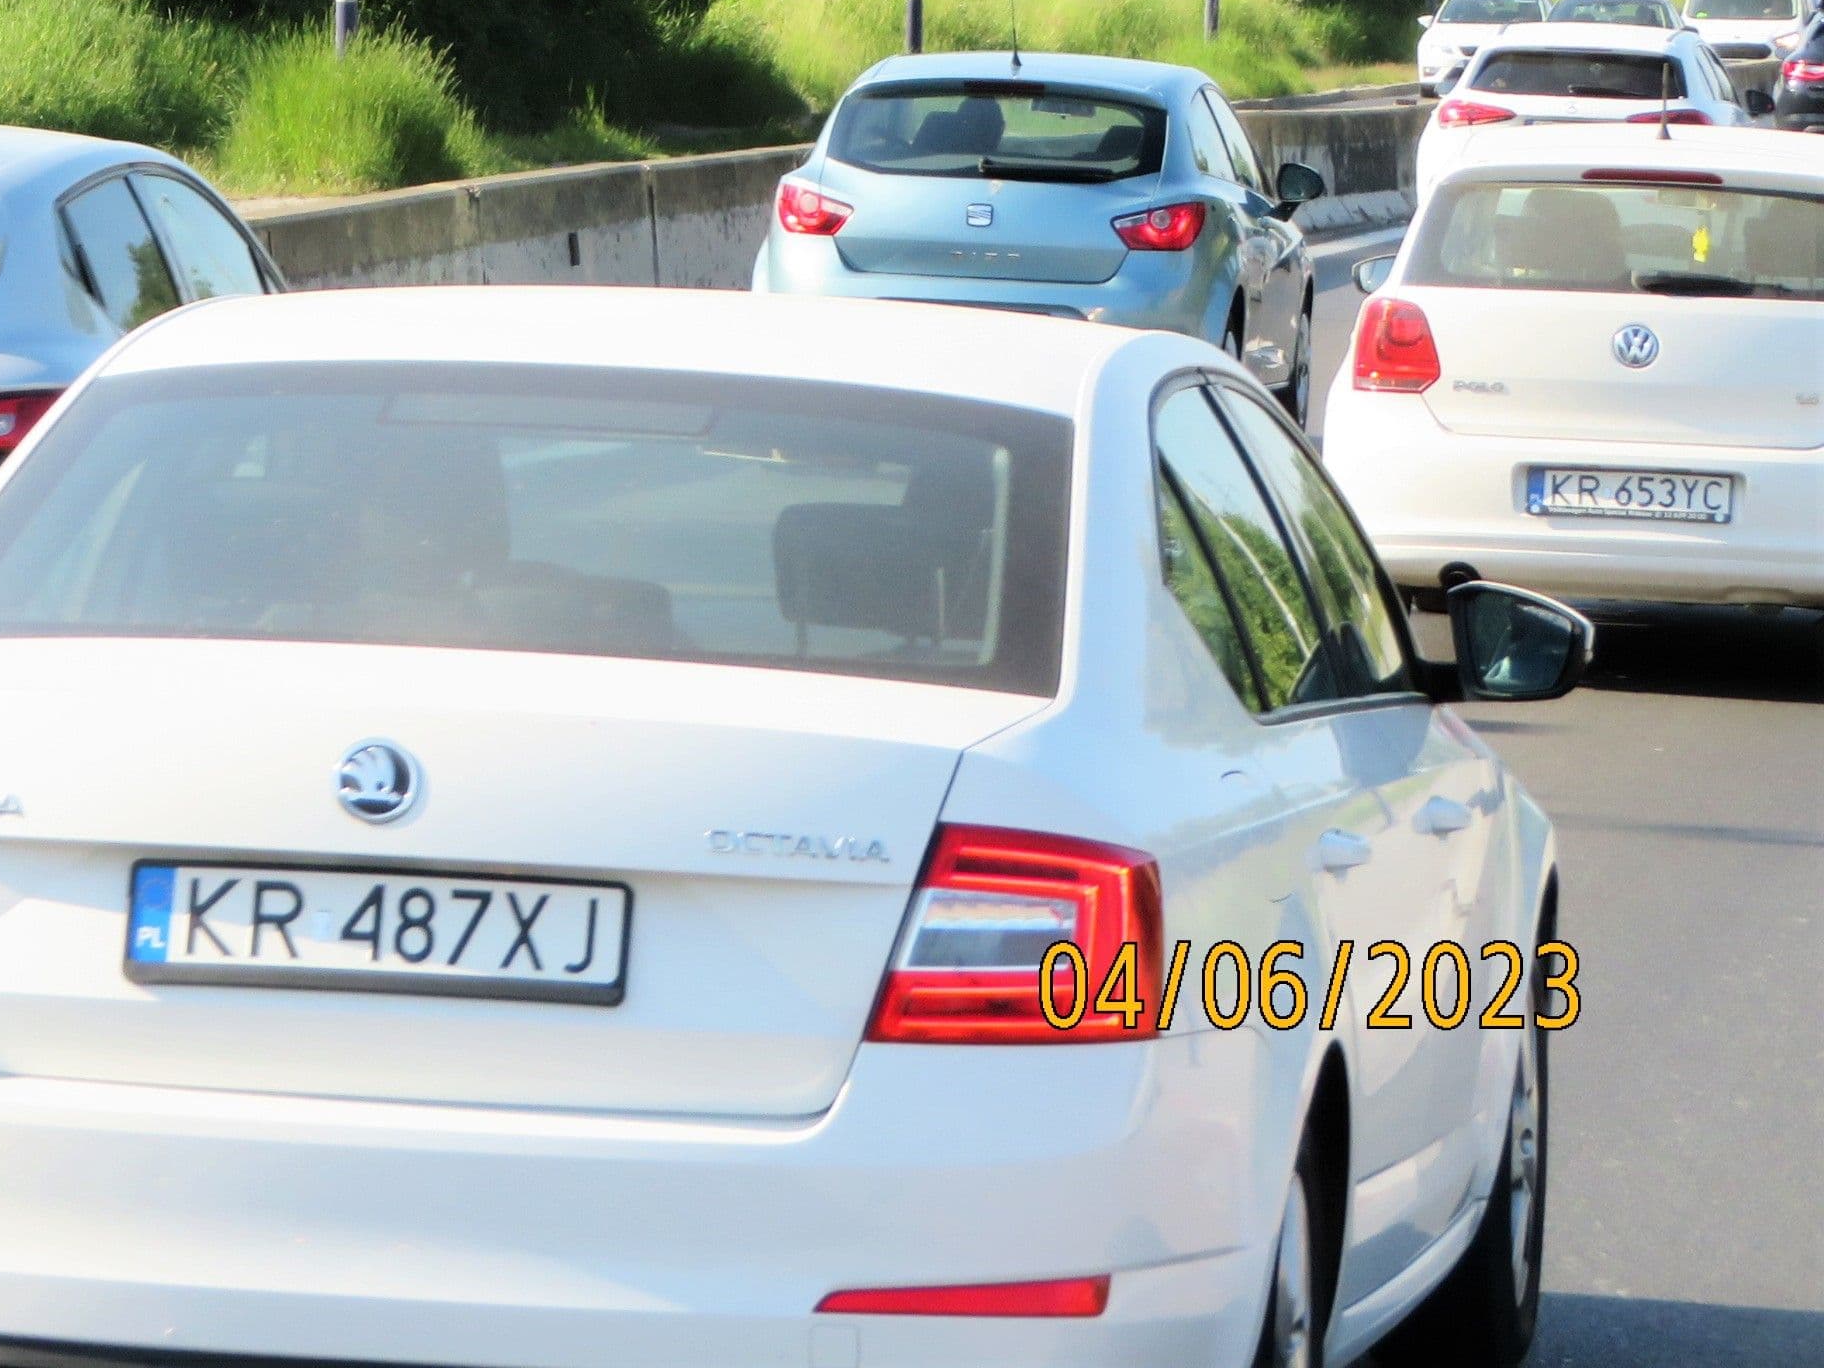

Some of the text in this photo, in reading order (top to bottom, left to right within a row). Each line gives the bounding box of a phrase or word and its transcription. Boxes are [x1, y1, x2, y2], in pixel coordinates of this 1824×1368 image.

[1551, 473, 1723, 512] KR 653YC
[705, 830, 891, 864] OCTAVIA
[136, 925, 165, 949] PL
[185, 876, 600, 974] KR 487XJ
